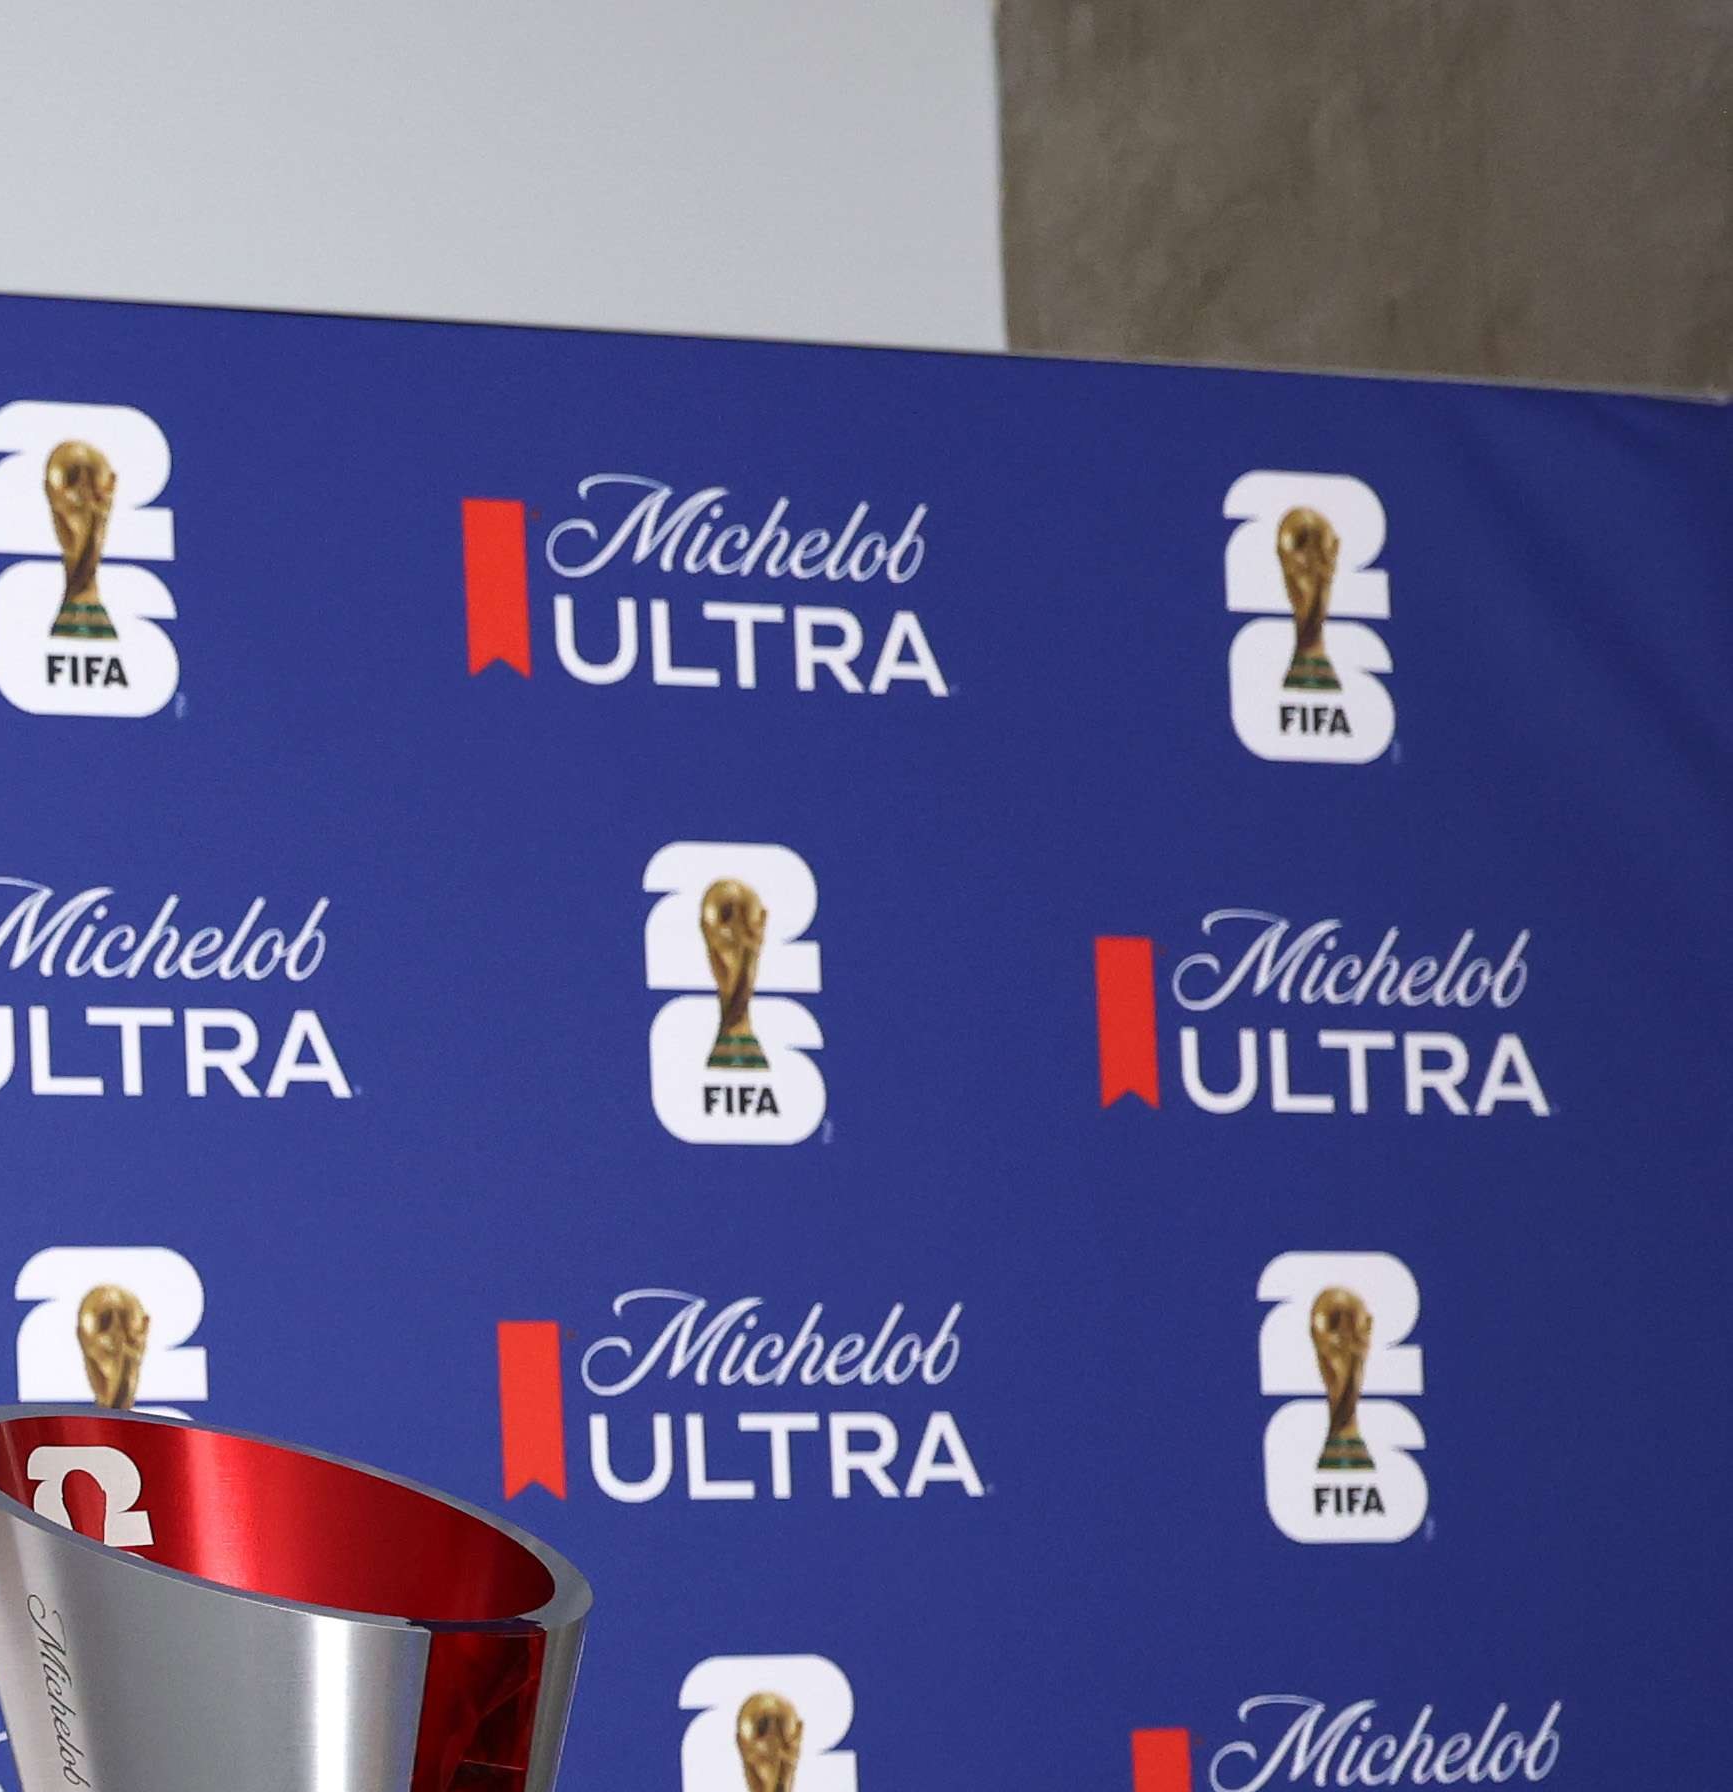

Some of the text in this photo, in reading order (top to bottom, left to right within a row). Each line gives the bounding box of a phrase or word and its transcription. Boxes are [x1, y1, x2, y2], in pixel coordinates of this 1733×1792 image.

[545, 473, 929, 584] Michelob
[46, 654, 129, 688] FIFA
[553, 593, 950, 698] ULTRA
[1279, 705, 1351, 735] FIFA
[1171, 908, 1531, 1012] Michelob
[703, 1085, 780, 1116] FIFA
[1179, 1026, 1552, 1118] ULTRA
[580, 1287, 963, 1397] Michelob
[588, 1410, 986, 1504] ULTRA
[1313, 1486, 1385, 1514] FIFA
[26, 1593, 92, 1789] Michelob
